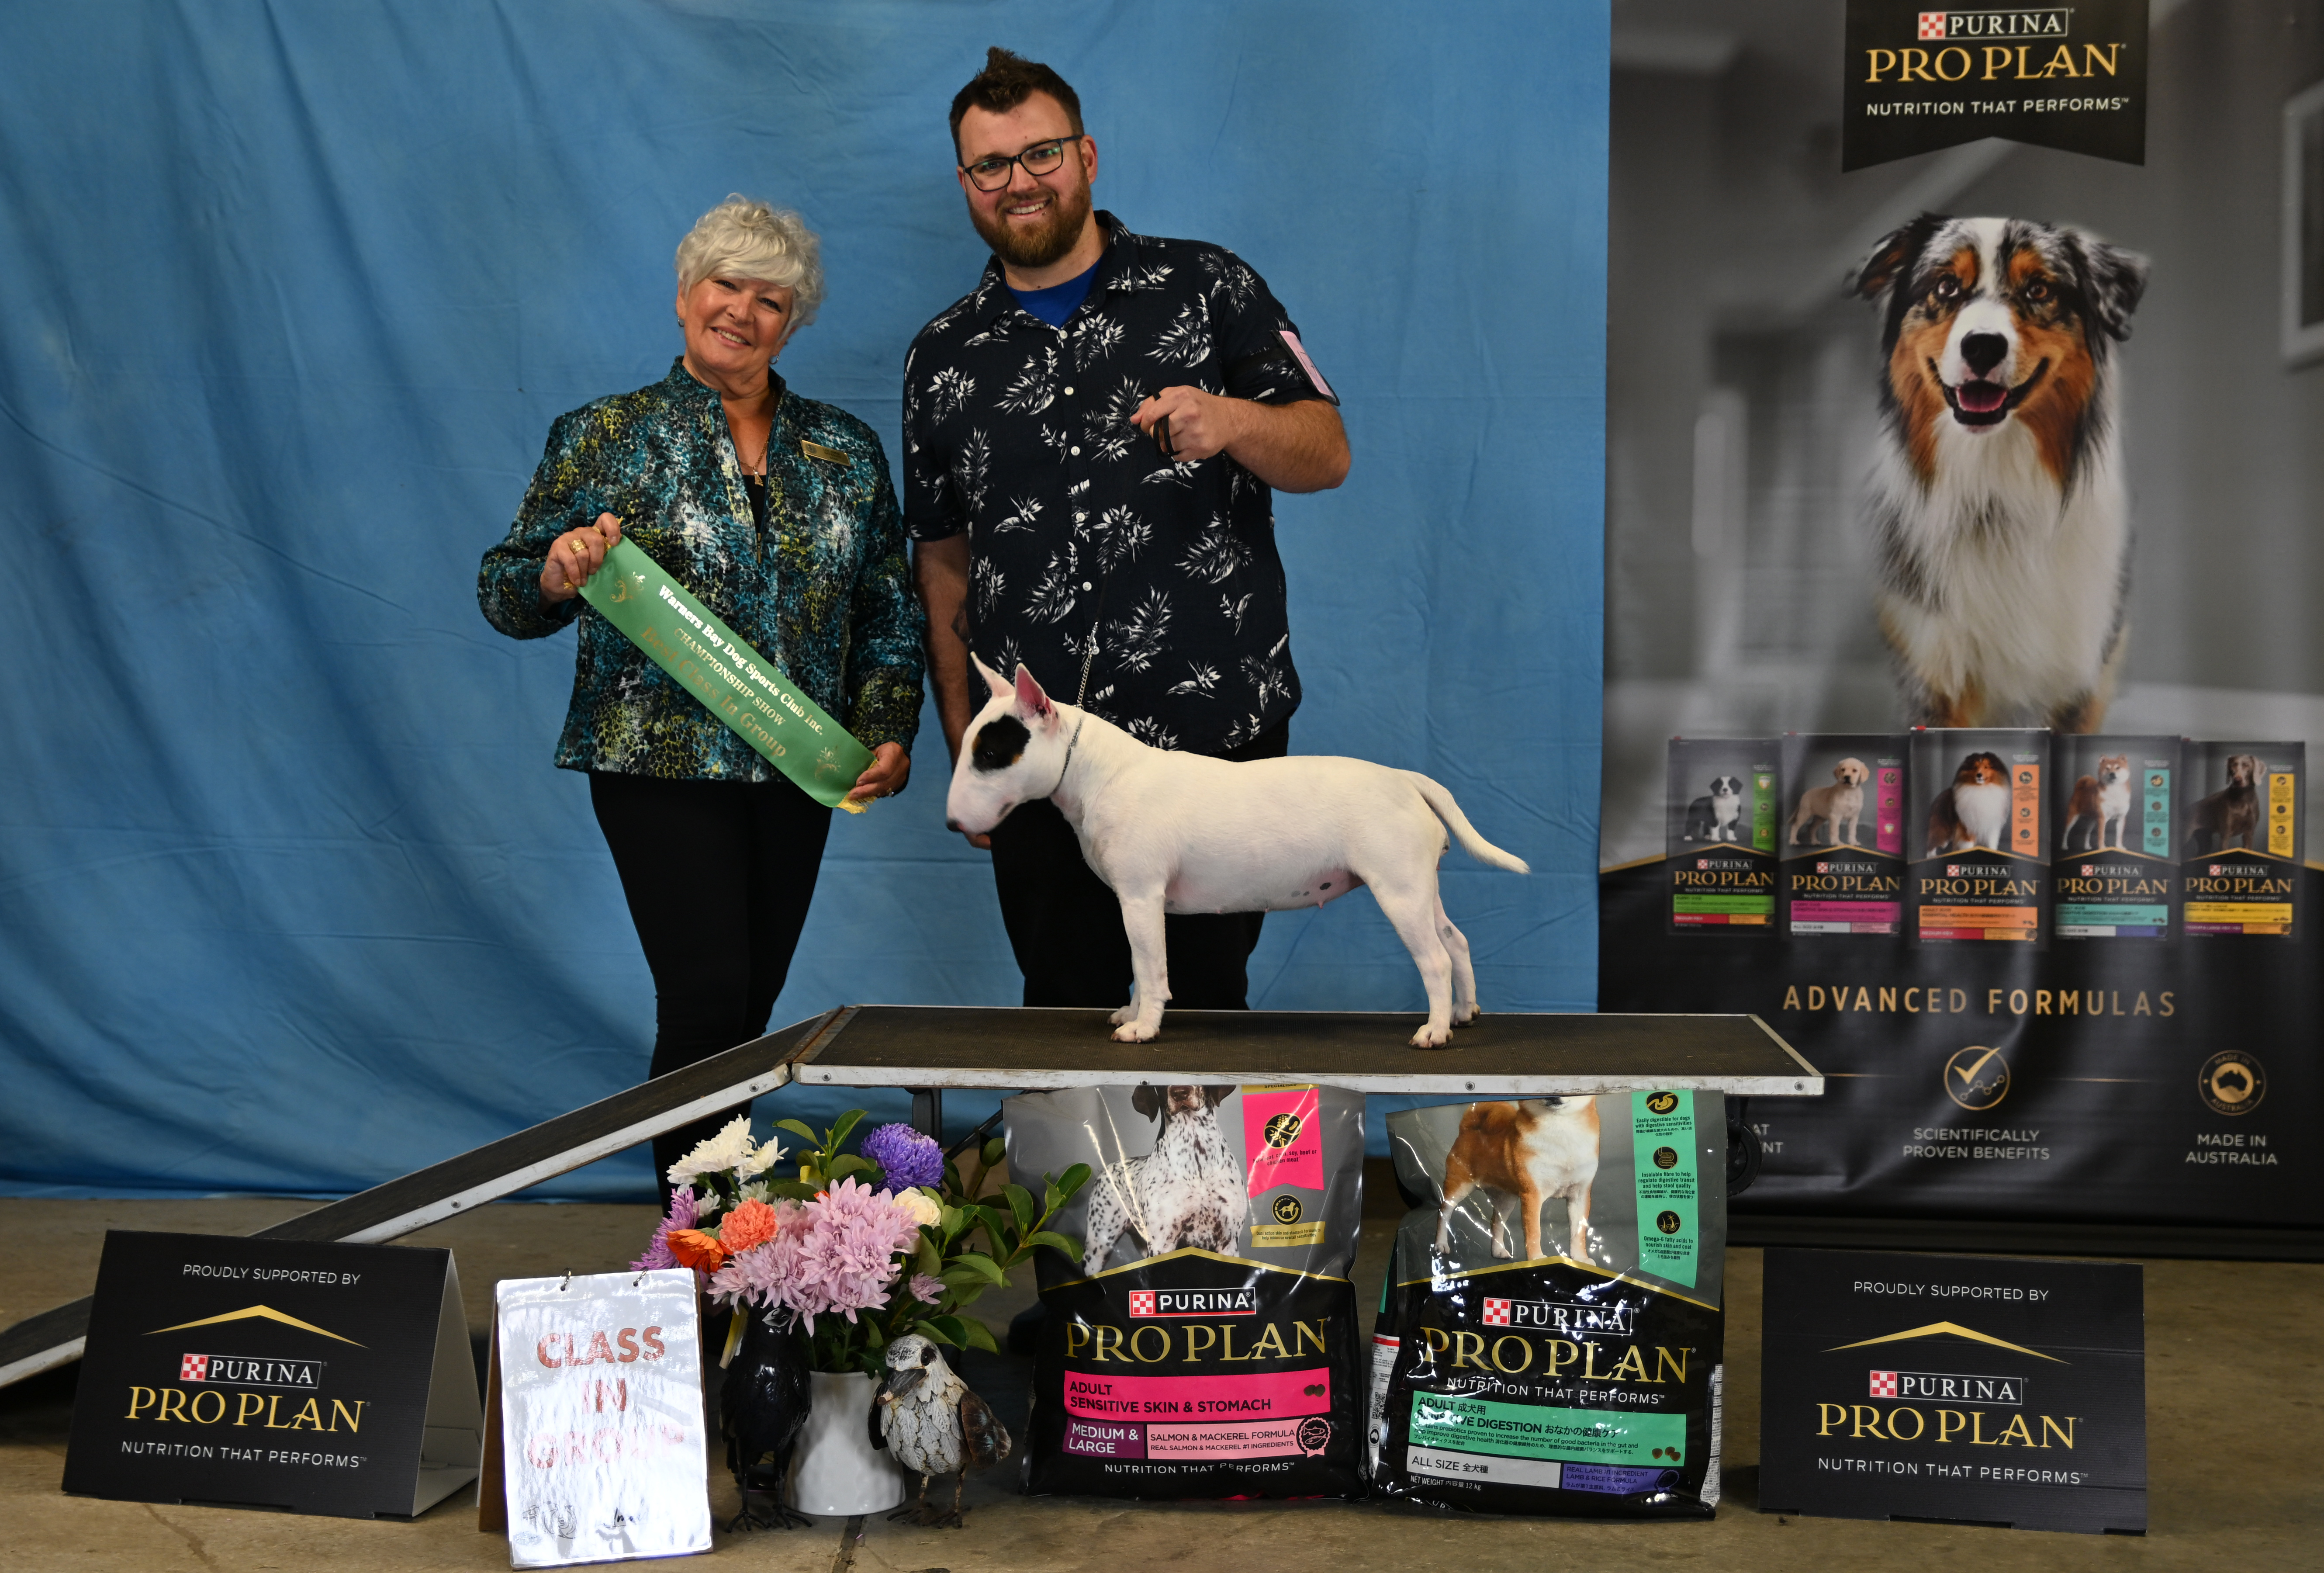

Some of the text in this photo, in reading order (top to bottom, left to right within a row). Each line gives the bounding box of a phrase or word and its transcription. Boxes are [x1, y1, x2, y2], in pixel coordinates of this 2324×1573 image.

[1949, 13, 2062, 36] PURINA
[1865, 43, 2121, 83] PRO PLAN
[1867, 101, 1964, 116] NUTRITION
[1971, 100, 2016, 114] THAT
[659, 584, 823, 736] Warners Bay Dog Sports Club Inc.
[674, 627, 786, 726] CHAMPIONSHIP SHOW
[640, 626, 786, 757] Best Class In Group
[1708, 860, 1750, 869] PURINA
[1829, 863, 1874, 872] PURINA
[1961, 866, 2007, 876] PURINA
[2095, 866, 2139, 876] PURINA
[2222, 866, 2264, 876] PURINA
[1674, 870, 1774, 887] PRO PLAN
[1791, 874, 1900, 891] PRO PLAN
[1920, 878, 2037, 896] PRO PLAN
[2057, 878, 2169, 894] PRO PLAN
[2186, 877, 2293, 894] PRO PLAN
[1783, 985, 2176, 1018] ADVANCED FORMULAS
[1913, 1127, 2040, 1142] SCIENTIFICALLY
[2197, 1133, 2267, 1147] MADE IN
[1902, 1144, 2050, 1160] PROVEN BENEFITS
[2186, 1150, 2279, 1166] AUSTRALIA
[183, 1264, 362, 1285] PROUDLY SUPPORTED BY
[1854, 1281, 2050, 1302] PROUDLY SUPPORTED BY
[536, 1325, 666, 1369] CLASS
[1064, 1322, 1172, 1363] PRO
[1419, 1326, 1533, 1374] PRO
[209, 1359, 314, 1385] PURINA
[581, 1377, 628, 1415] IN
[1069, 1381, 1113, 1396] ADULT
[1447, 1377, 1529, 1396] NUTRITION
[1535, 1386, 1575, 1399] THAT
[1902, 1376, 2017, 1401] PURINA
[124, 1386, 366, 1434] PRO PLAN
[1070, 1396, 1272, 1413] SENSITIVE SKIN & STOMACH
[1418, 1396, 1487, 1416] ADULT 成犬用
[1072, 1422, 1139, 1441] MEDIUM &
[1150, 1433, 1190, 1441] SALMON
[1200, 1432, 1250, 1441] MACKEREL
[1251, 1429, 1296, 1440] FORMULA
[1427, 1430, 1449, 1438] improve
[1450, 1433, 1476, 1441] digestive
[1439, 1425, 1466, 1434] prebiotics
[1477, 1418, 1619, 1439] DIGESTION おなかの健康ケア
[1816, 1403, 2078, 1450] PRO PLAN
[121, 1440, 214, 1459] NUTRITION
[219, 1446, 263, 1462] THAT
[1069, 1437, 1116, 1454] LARGE
[1251, 1441, 1294, 1449] INGREDIENTS
[1104, 1464, 1176, 1474] NUTRITION
[1181, 1464, 1215, 1473] THAT
[1411, 1455, 1489, 1474] ALL SIZE 全犬種
[1818, 1457, 1919, 1475] NUTRITION
[1926, 1463, 1973, 1478] THAT
[1410, 1475, 1421, 1484] NET
[1421, 1477, 1444, 1486] WEIGHT
[1474, 1483, 1481, 1491] kg
